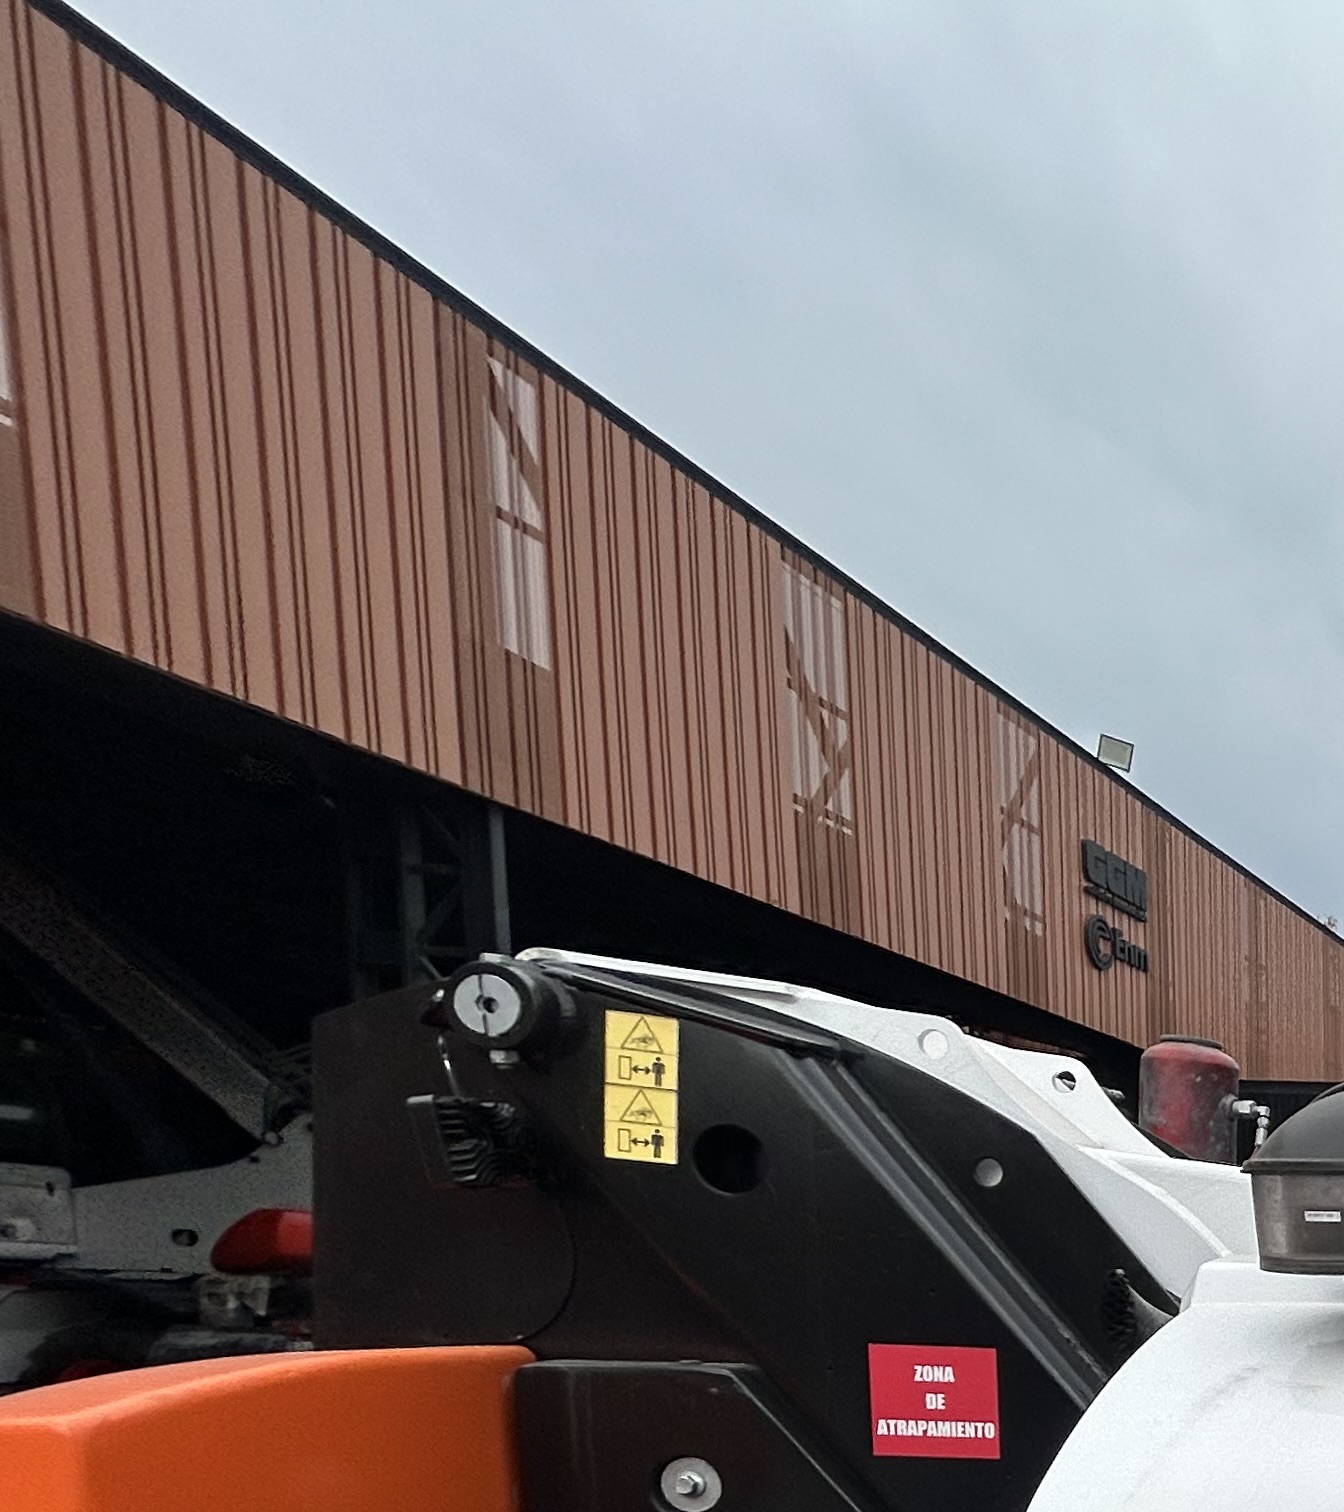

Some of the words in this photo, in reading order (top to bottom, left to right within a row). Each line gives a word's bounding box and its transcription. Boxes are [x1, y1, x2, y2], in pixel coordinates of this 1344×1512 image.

[914, 1365, 955, 1382] ZONA
[925, 1393, 946, 1410] DE
[876, 1419, 995, 1439] ATRAPAMIENTO
